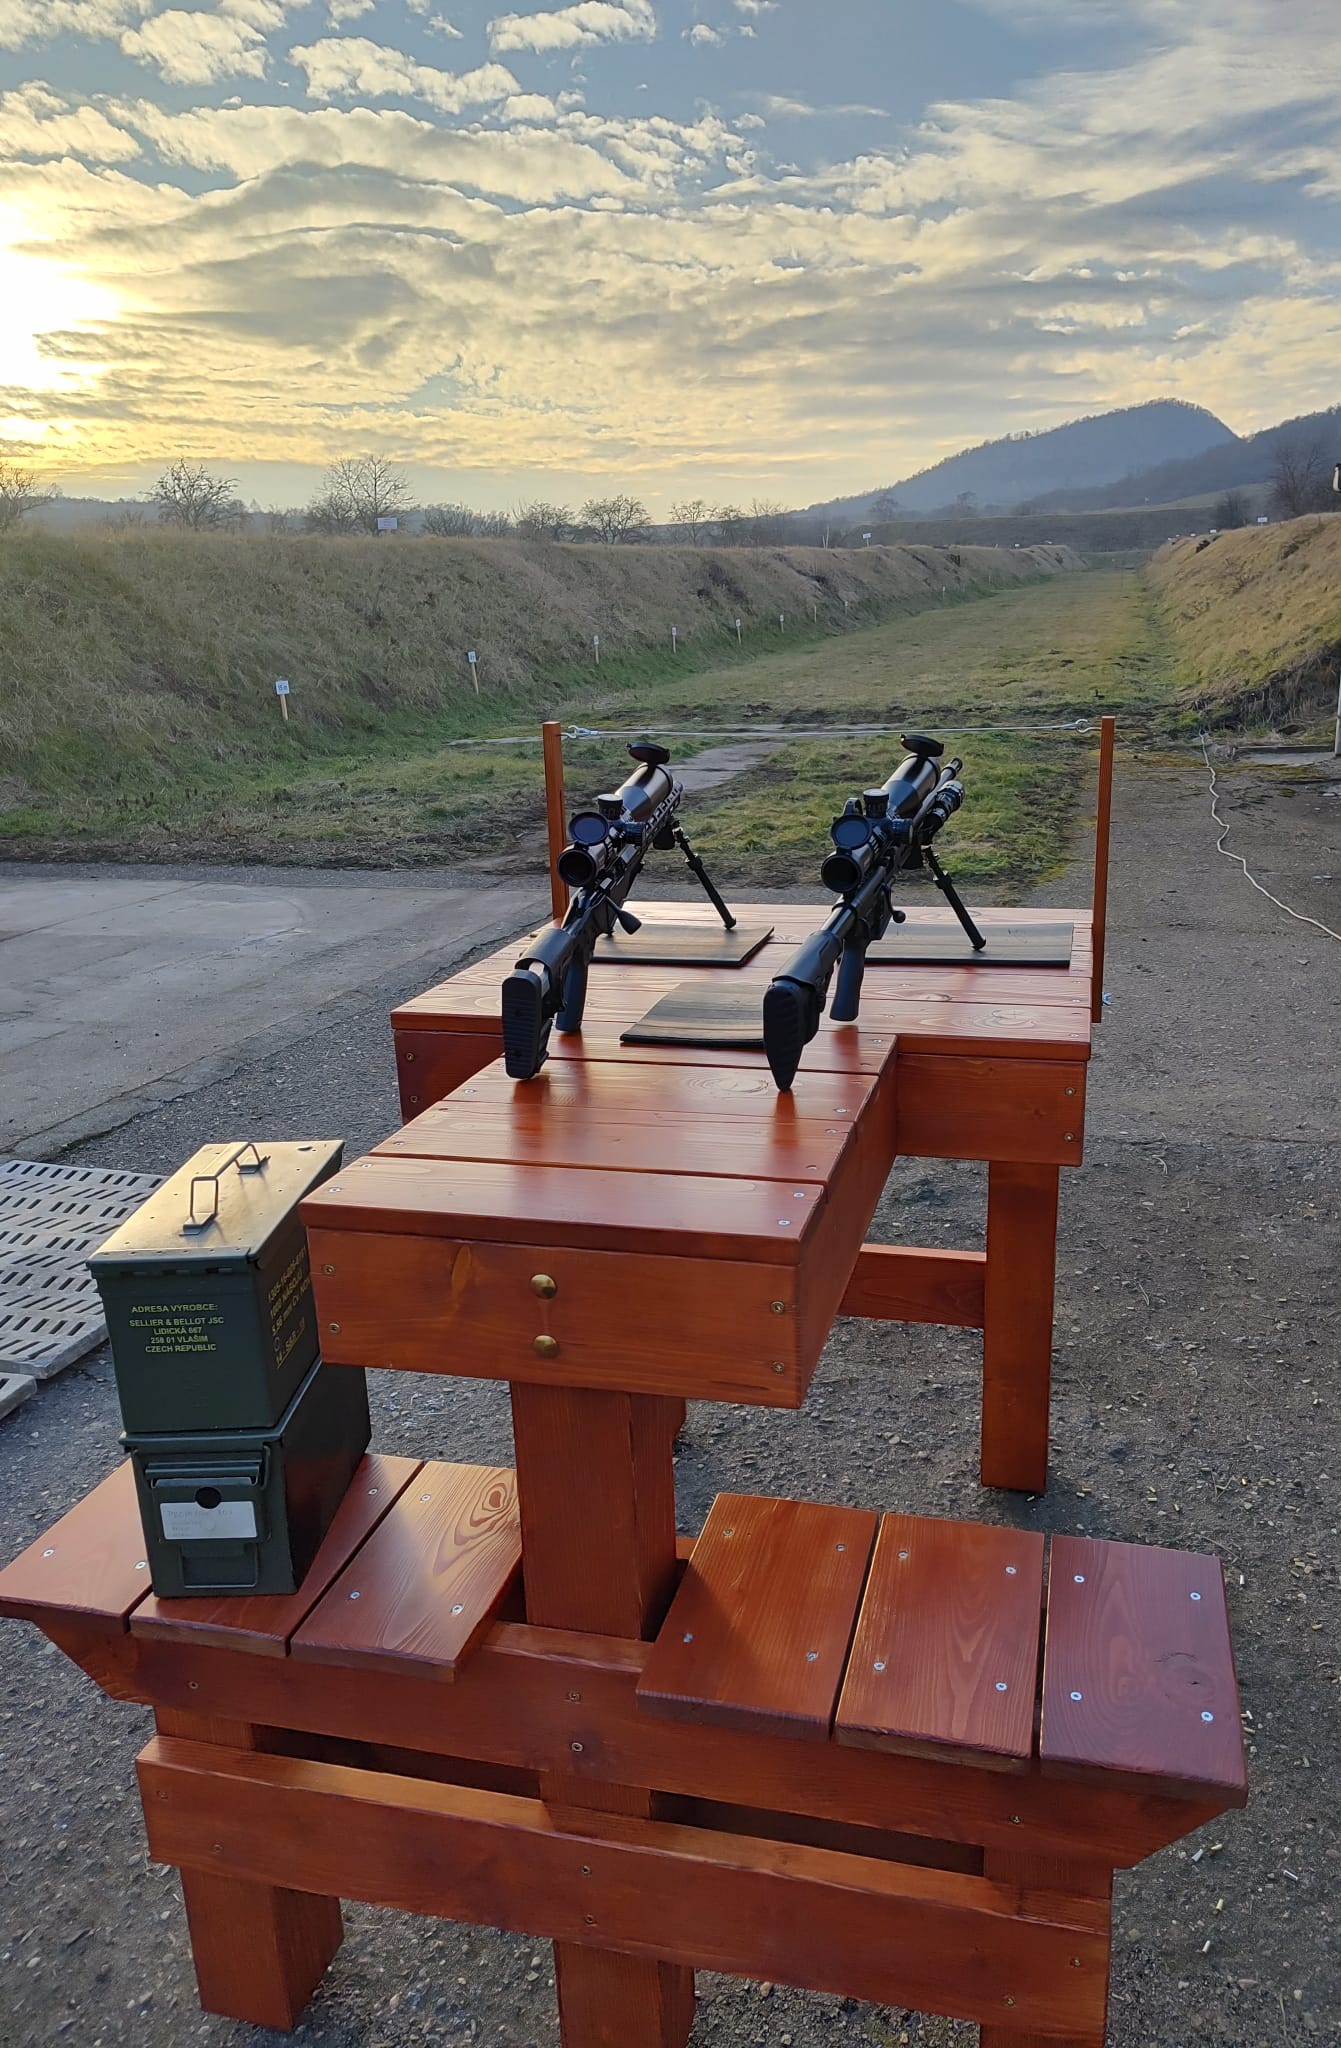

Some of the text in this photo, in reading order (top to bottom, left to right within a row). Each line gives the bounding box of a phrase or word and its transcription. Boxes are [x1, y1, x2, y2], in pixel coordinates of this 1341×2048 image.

[131, 1305, 169, 1313] ADRESA
[129, 1316, 225, 1327] SELLIER & BELLOT JSC
[153, 1325, 187, 1335] LIDICKÁ
[166, 1336, 175, 1344] 01
[145, 1343, 217, 1353] CZECH REPUBLIC
